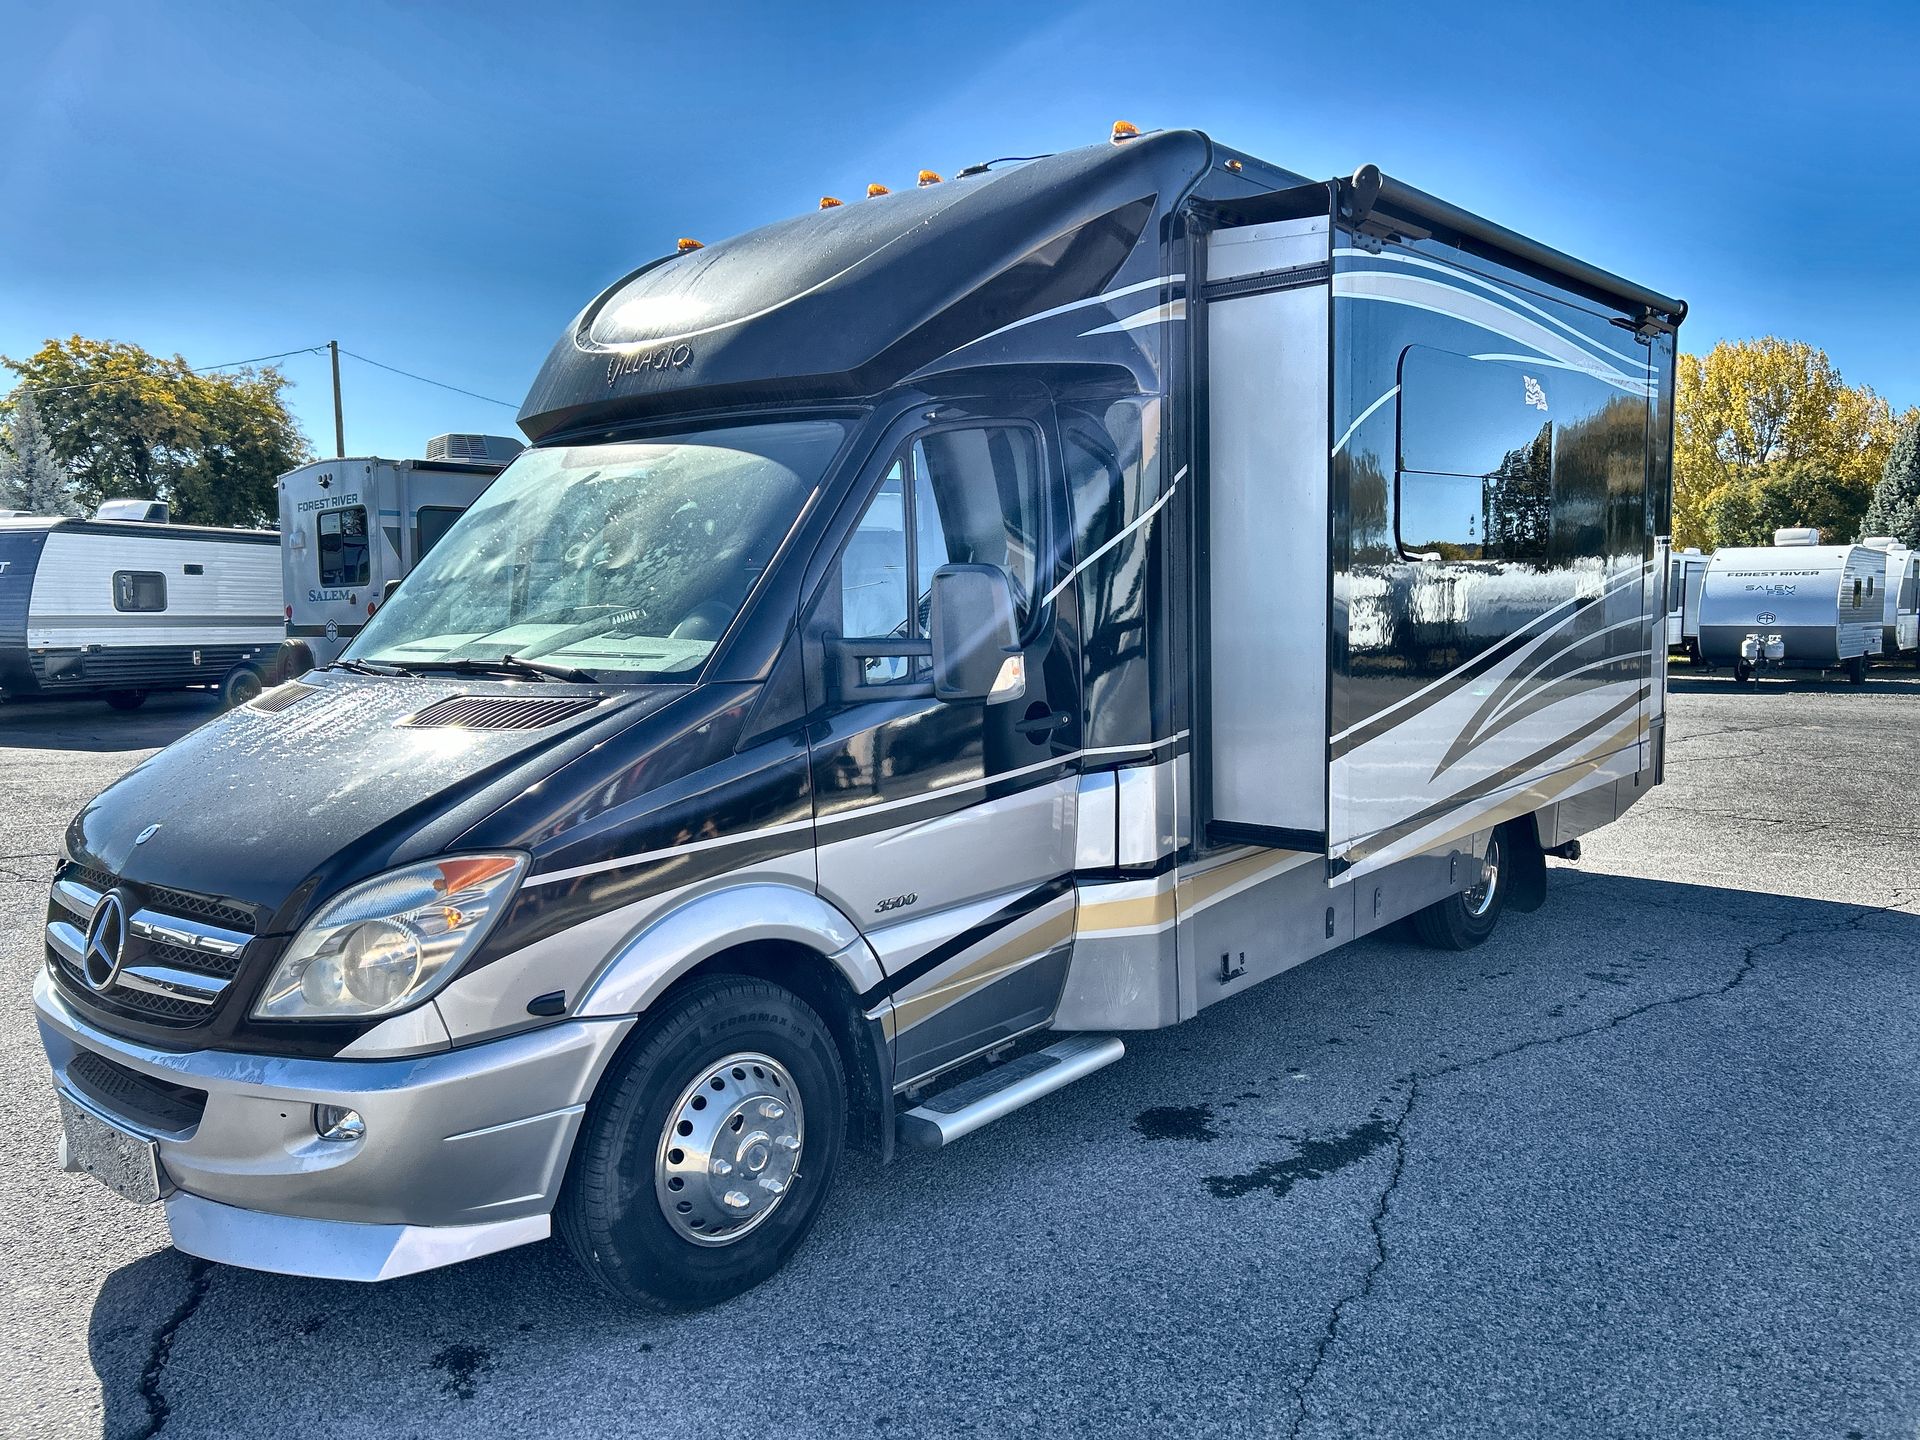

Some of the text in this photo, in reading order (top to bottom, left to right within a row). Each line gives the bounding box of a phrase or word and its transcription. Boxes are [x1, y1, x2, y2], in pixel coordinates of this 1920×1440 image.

[607, 344, 692, 388] VILLAGIO
[297, 493, 358, 512] FOREST RIVER
[308, 589, 351, 602] SALEM
[874, 892, 918, 913] 3500
[711, 1012, 788, 1034] TERRAMAX
